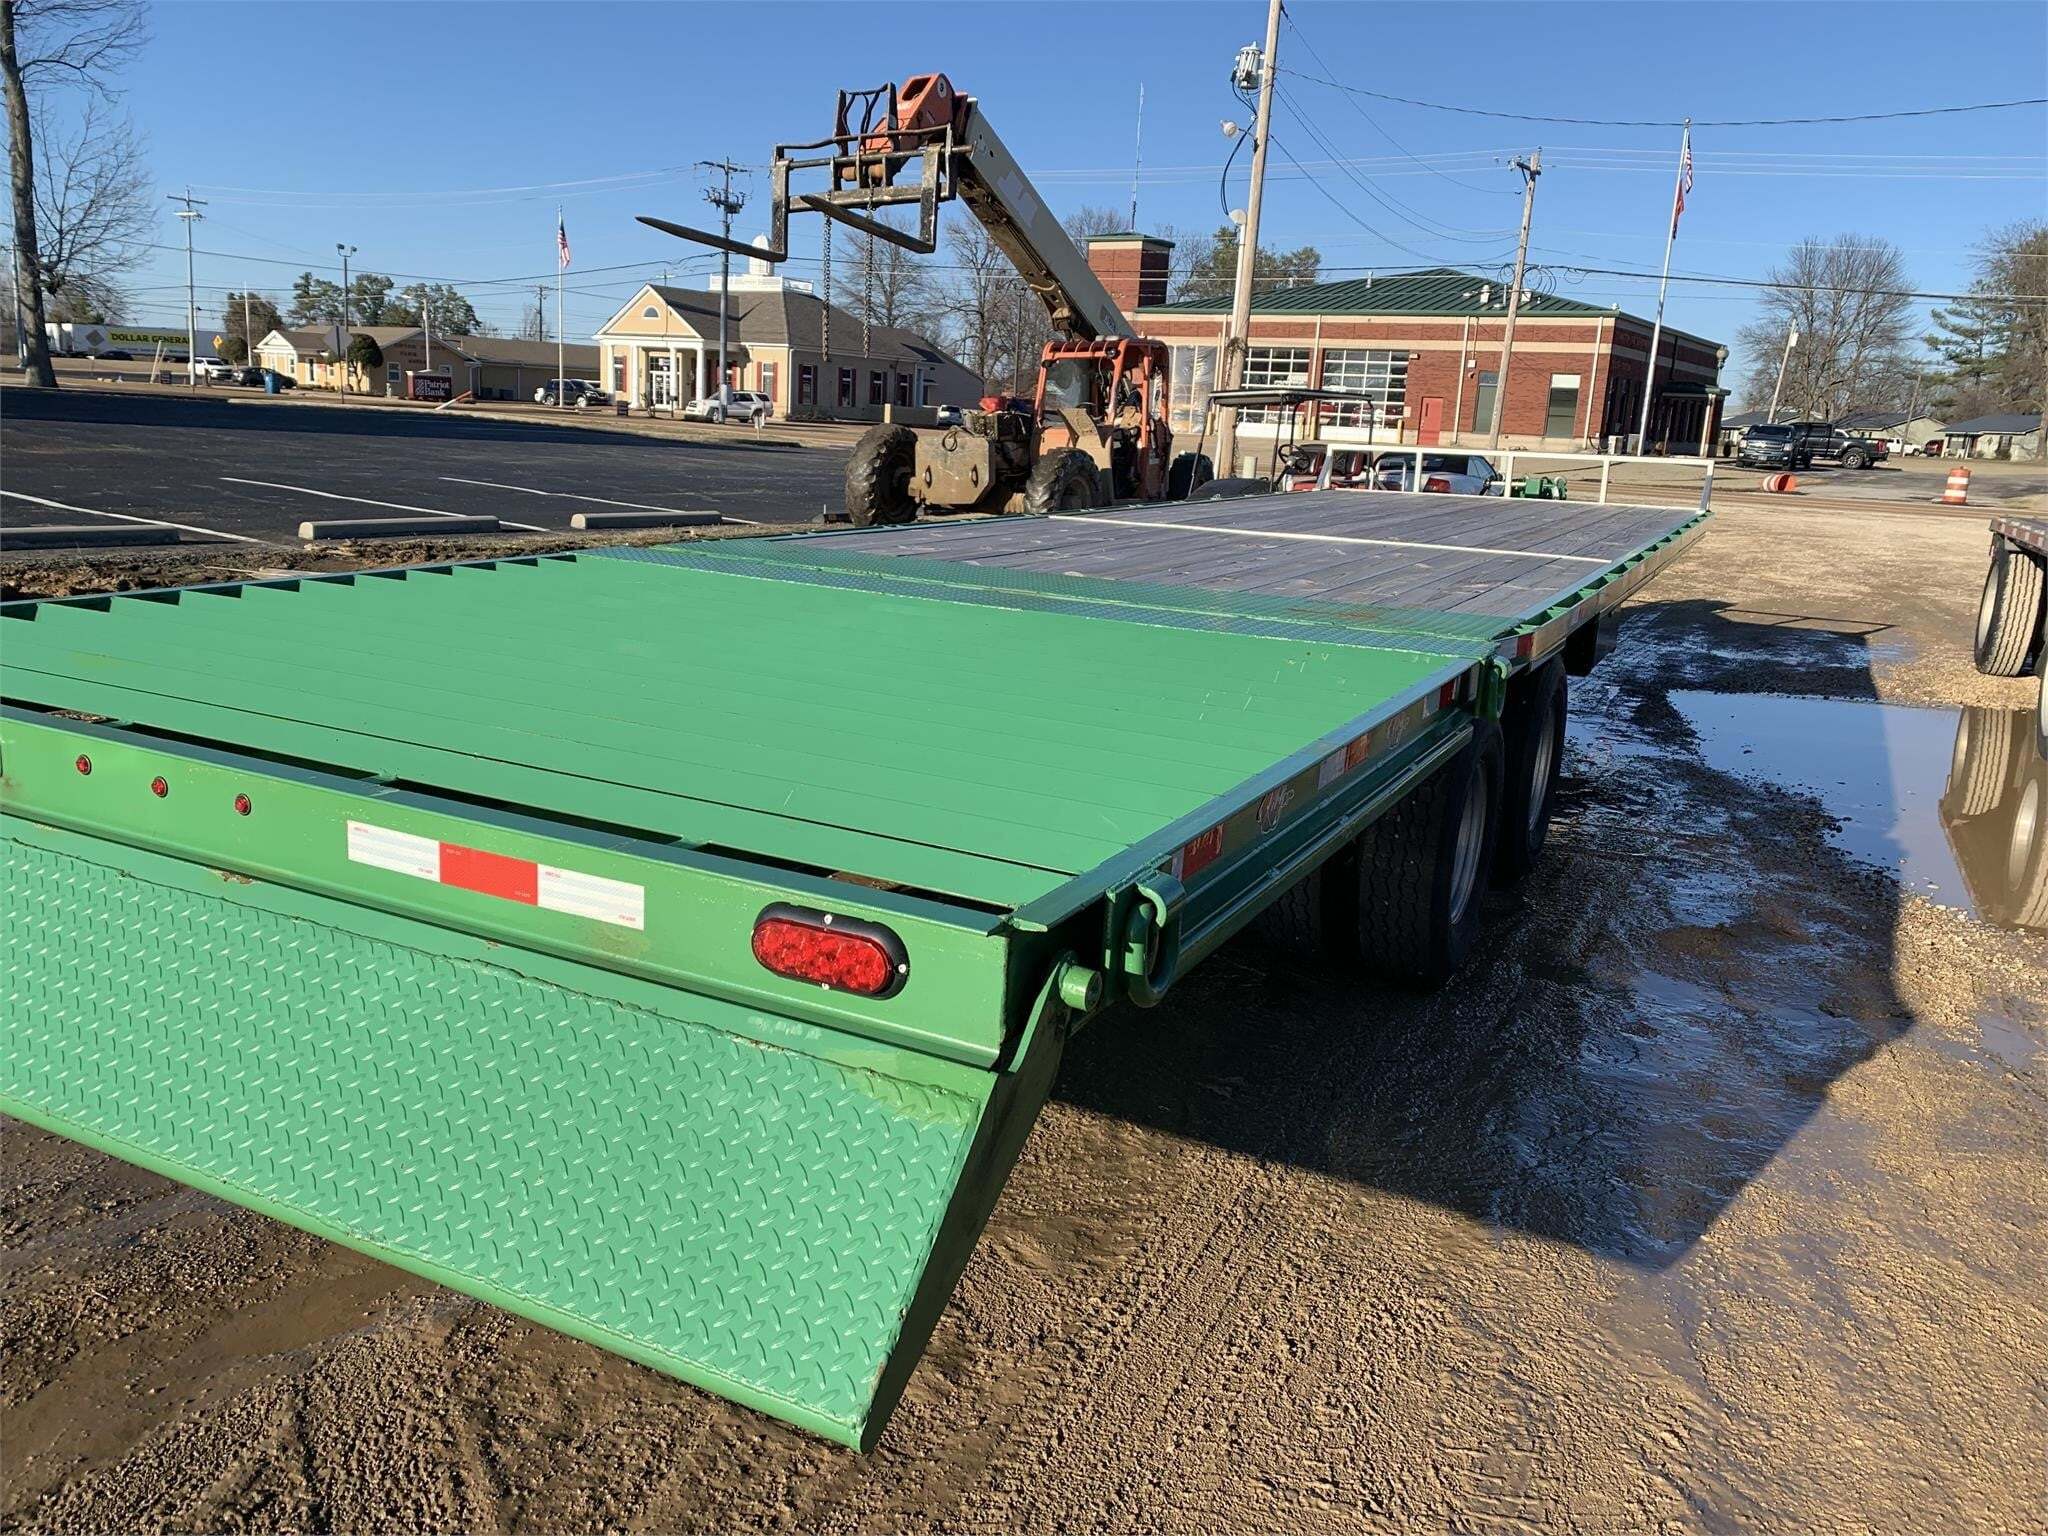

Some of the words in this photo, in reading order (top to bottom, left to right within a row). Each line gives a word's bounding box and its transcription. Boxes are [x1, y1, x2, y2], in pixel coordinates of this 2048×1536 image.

[111, 333, 149, 342] DOLLAR
[425, 380, 449, 389] Patriot
[425, 388, 445, 396] Bank
